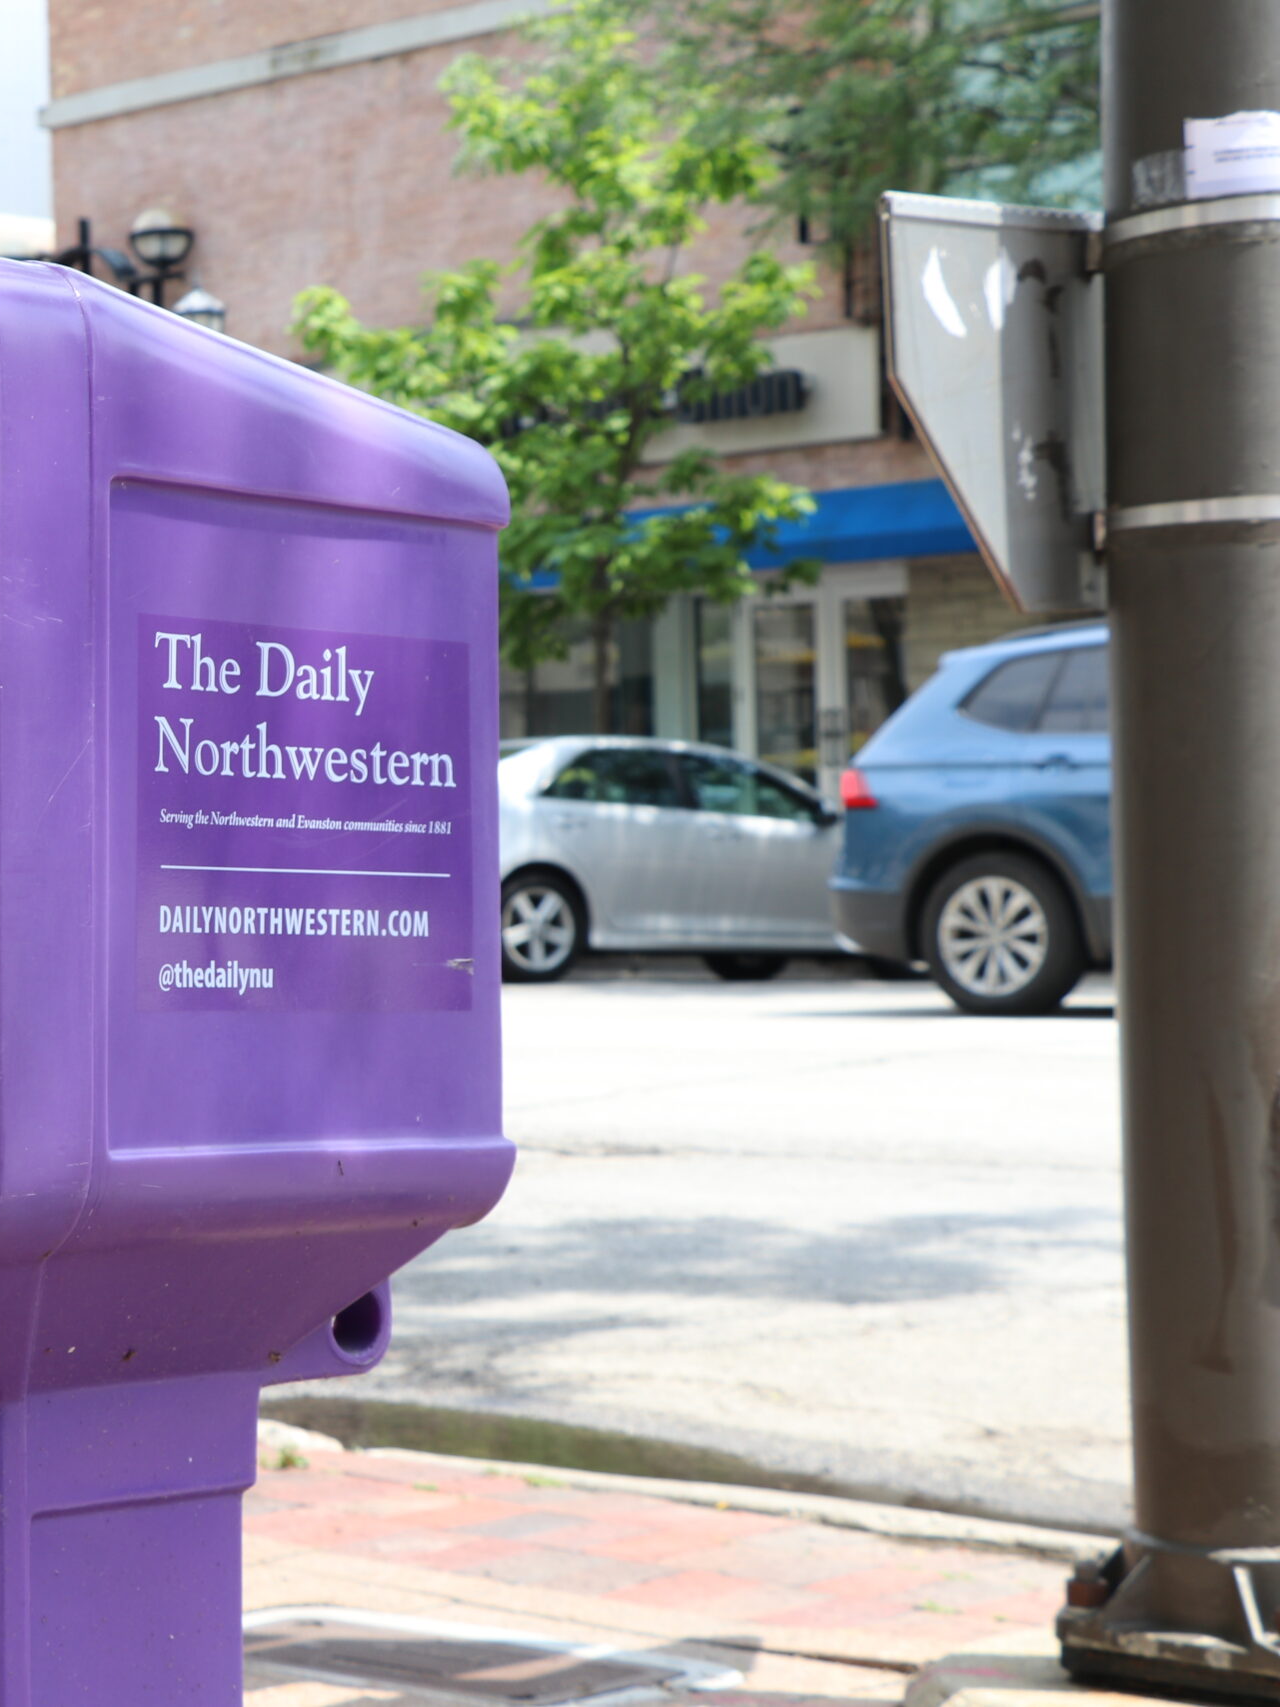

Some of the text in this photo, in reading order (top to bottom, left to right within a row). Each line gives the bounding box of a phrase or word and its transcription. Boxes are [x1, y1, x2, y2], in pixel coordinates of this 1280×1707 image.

[155, 632, 375, 716] The Daily
[154, 716, 457, 788] Northwestern
[160, 808, 452, 835] Serving the Northwestern and Evanston communities since 1881
[159, 905, 429, 937] DAILYNORTHWESTERN.COM
[159, 960, 274, 996] @thedailynu
